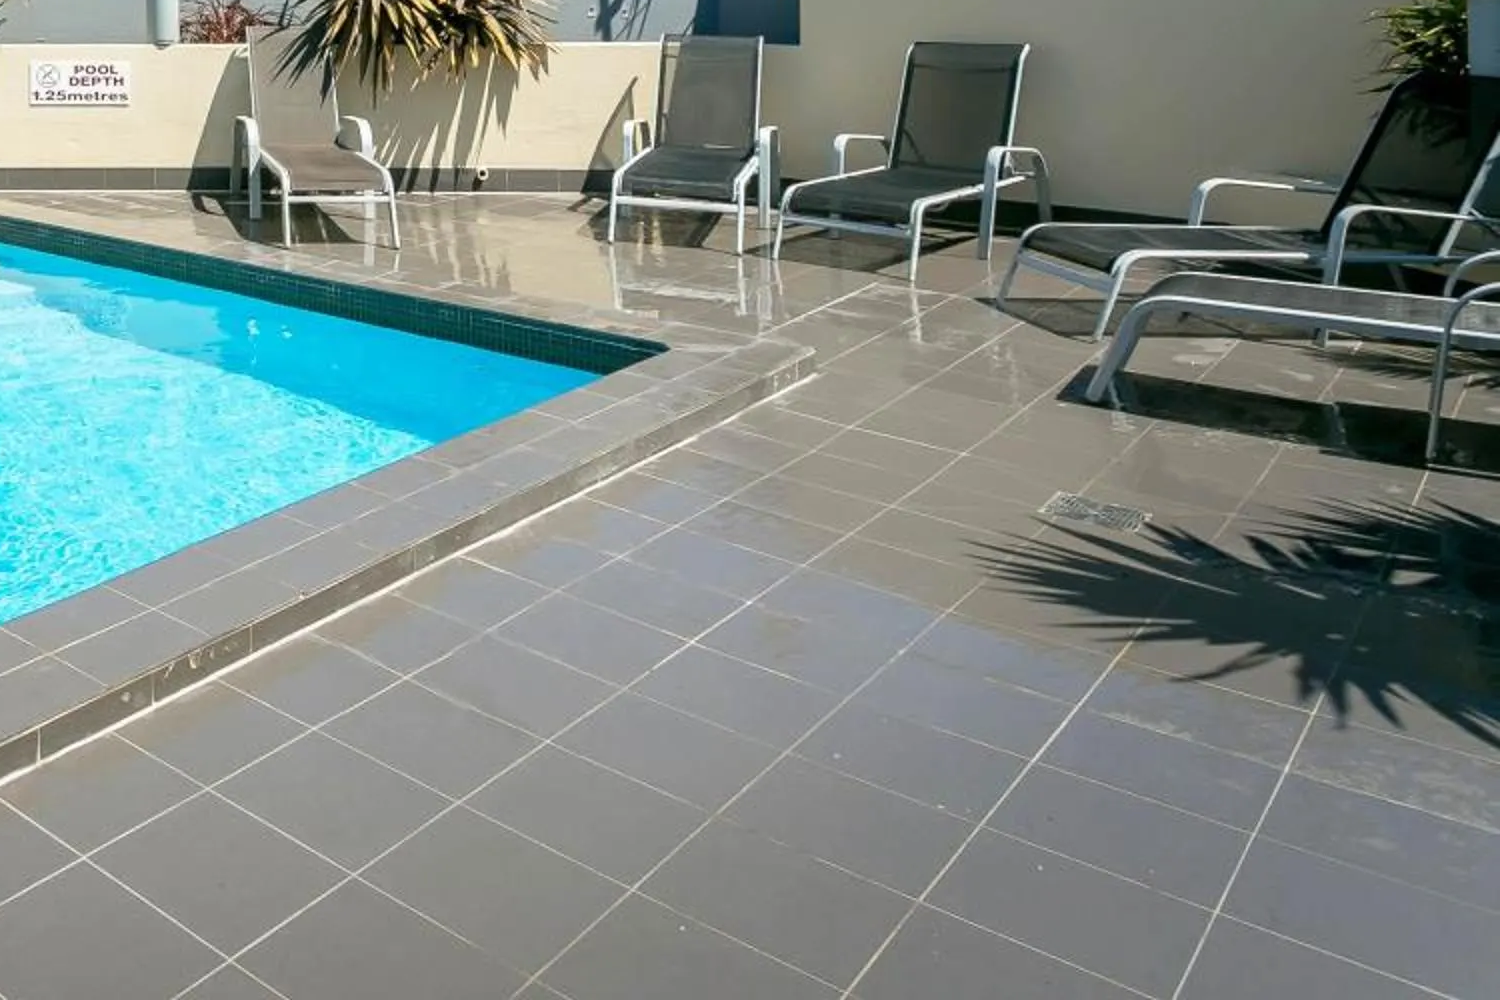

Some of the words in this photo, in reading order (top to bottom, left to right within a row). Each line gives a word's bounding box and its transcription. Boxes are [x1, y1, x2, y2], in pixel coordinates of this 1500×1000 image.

[73, 64, 118, 75] POOL
[69, 77, 124, 87] DEPTH
[33, 90, 129, 101] 1.25metres
